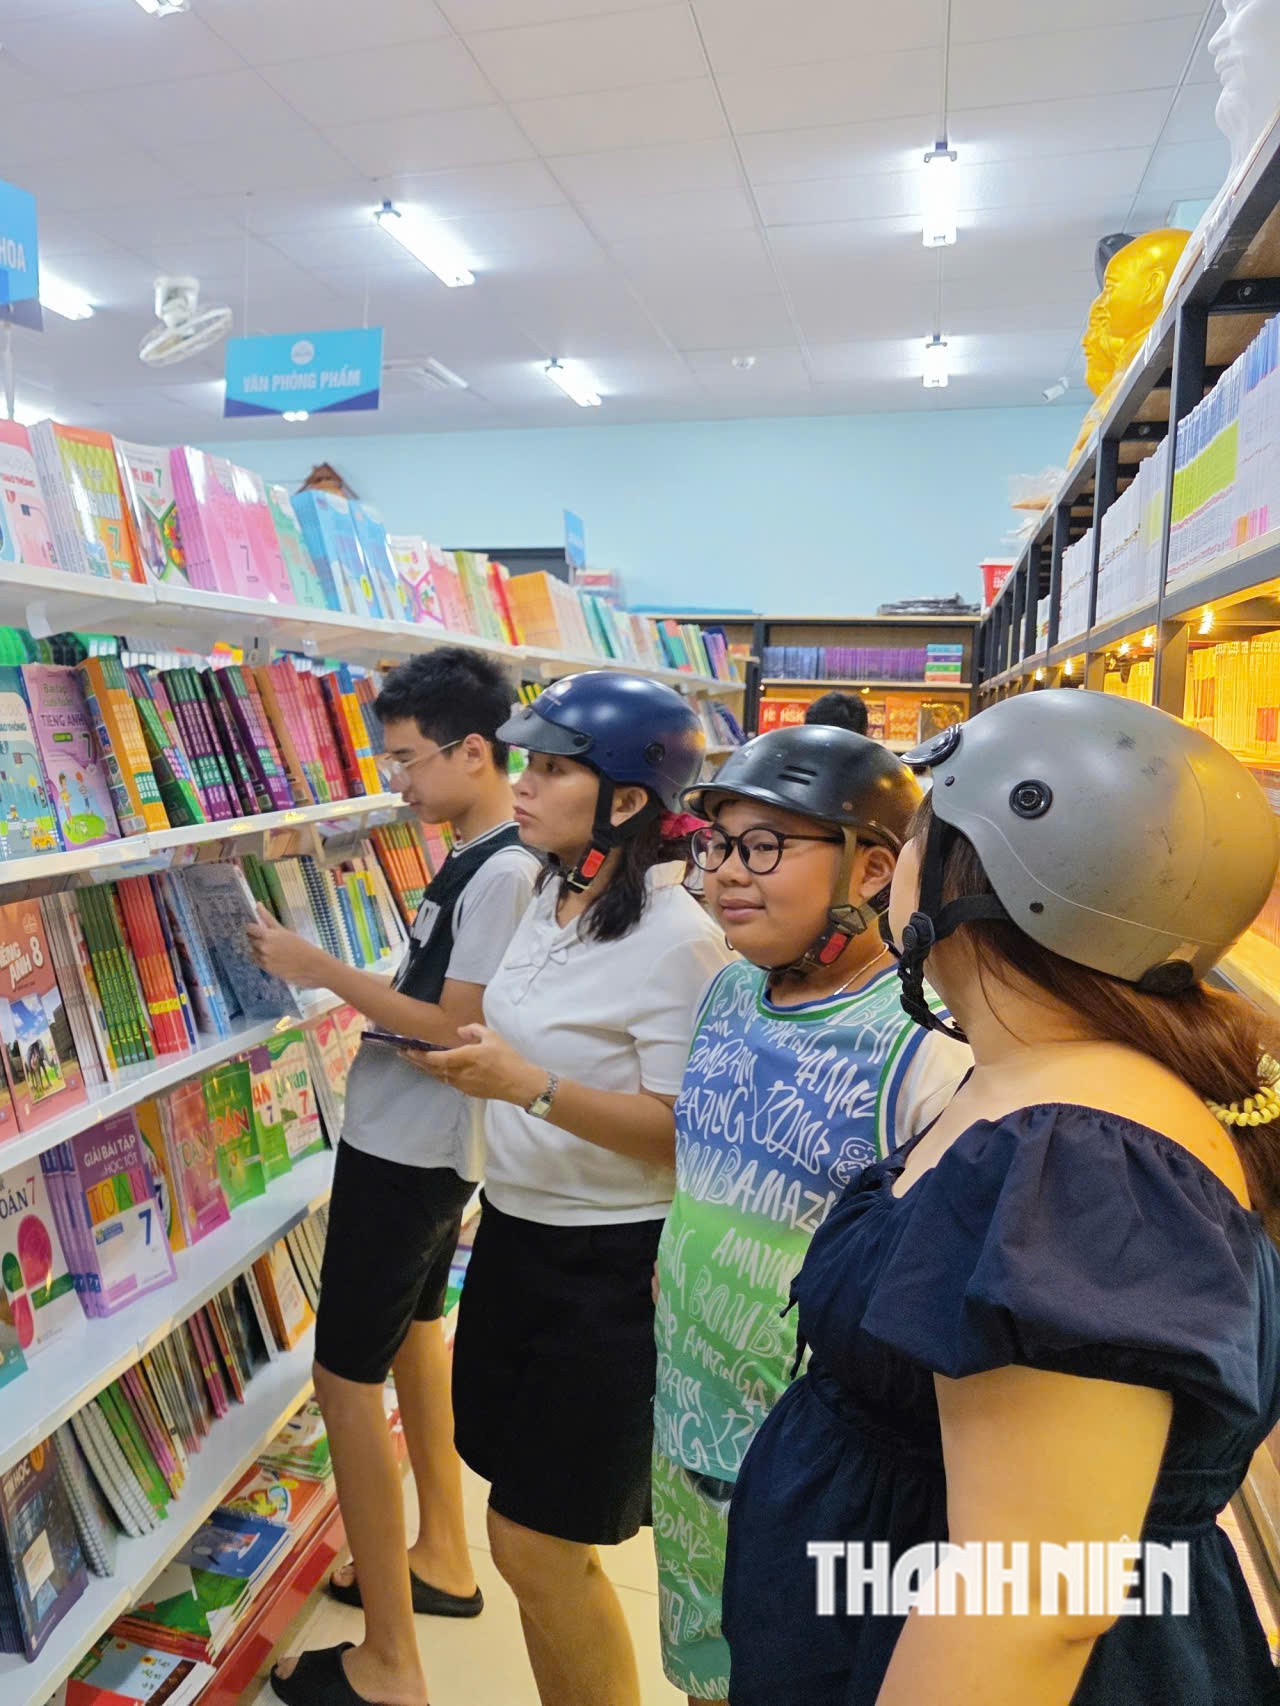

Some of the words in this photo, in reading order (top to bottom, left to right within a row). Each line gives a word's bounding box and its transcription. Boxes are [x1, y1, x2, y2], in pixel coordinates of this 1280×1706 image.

[243, 373, 269, 393] VĂN
[272, 370, 317, 391] PHÒNG
[320, 364, 361, 390] PHẨM
[9, 958, 32, 991] ANH
[30, 935, 44, 967] 8
[298, 1090, 308, 1115] 7
[84, 1149, 100, 1167] GIẢI
[101, 1142, 117, 1159] BÀI
[117, 1134, 136, 1153] TẬP
[26, 1176, 36, 1205] 7
[138, 1208, 152, 1245] 7
